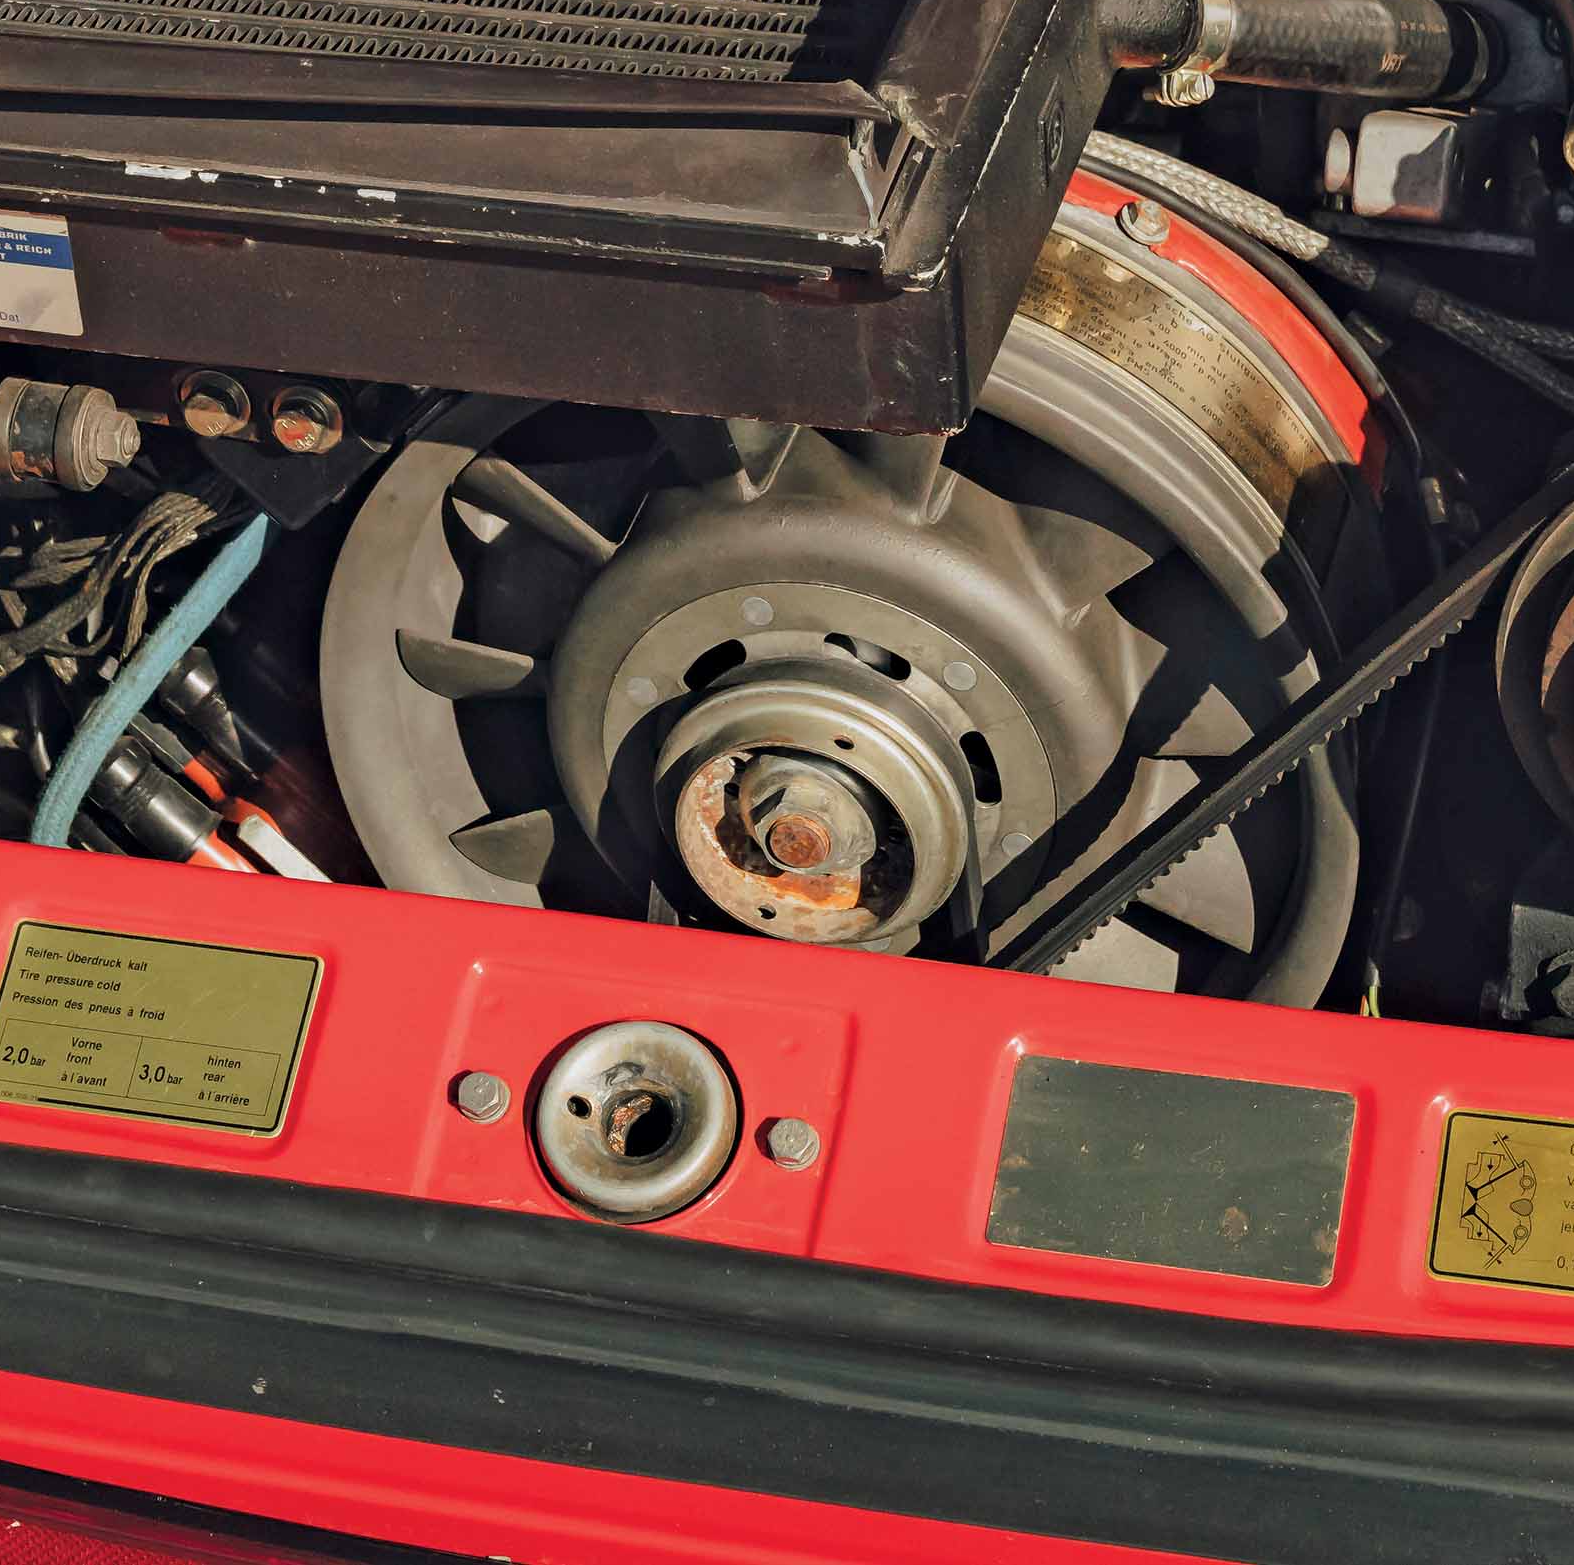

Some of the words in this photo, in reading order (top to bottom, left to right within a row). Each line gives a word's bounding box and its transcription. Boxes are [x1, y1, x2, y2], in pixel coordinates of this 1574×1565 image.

[4, 242, 12, 250] &
[16, 244, 51, 255] REICH
[25, 947, 63, 960] Reifen-
[128, 960, 148, 972] kalt
[20, 969, 40, 981] Tire
[45, 974, 93, 988] pressure
[97, 979, 121, 992] cold
[12, 992, 58, 1007] Pression
[65, 999, 83, 1010] des
[89, 1003, 121, 1015] pneus
[140, 1008, 165, 1021] froid
[72, 1037, 102, 1050] Vorne
[2, 1046, 29, 1065] 2,0
[30, 1056, 46, 1066] bar
[66, 1052, 92, 1065] front
[207, 1055, 241, 1069] hinten
[139, 1064, 165, 1084] 3,0
[167, 1074, 183, 1085] bar
[203, 1072, 225, 1082] rear
